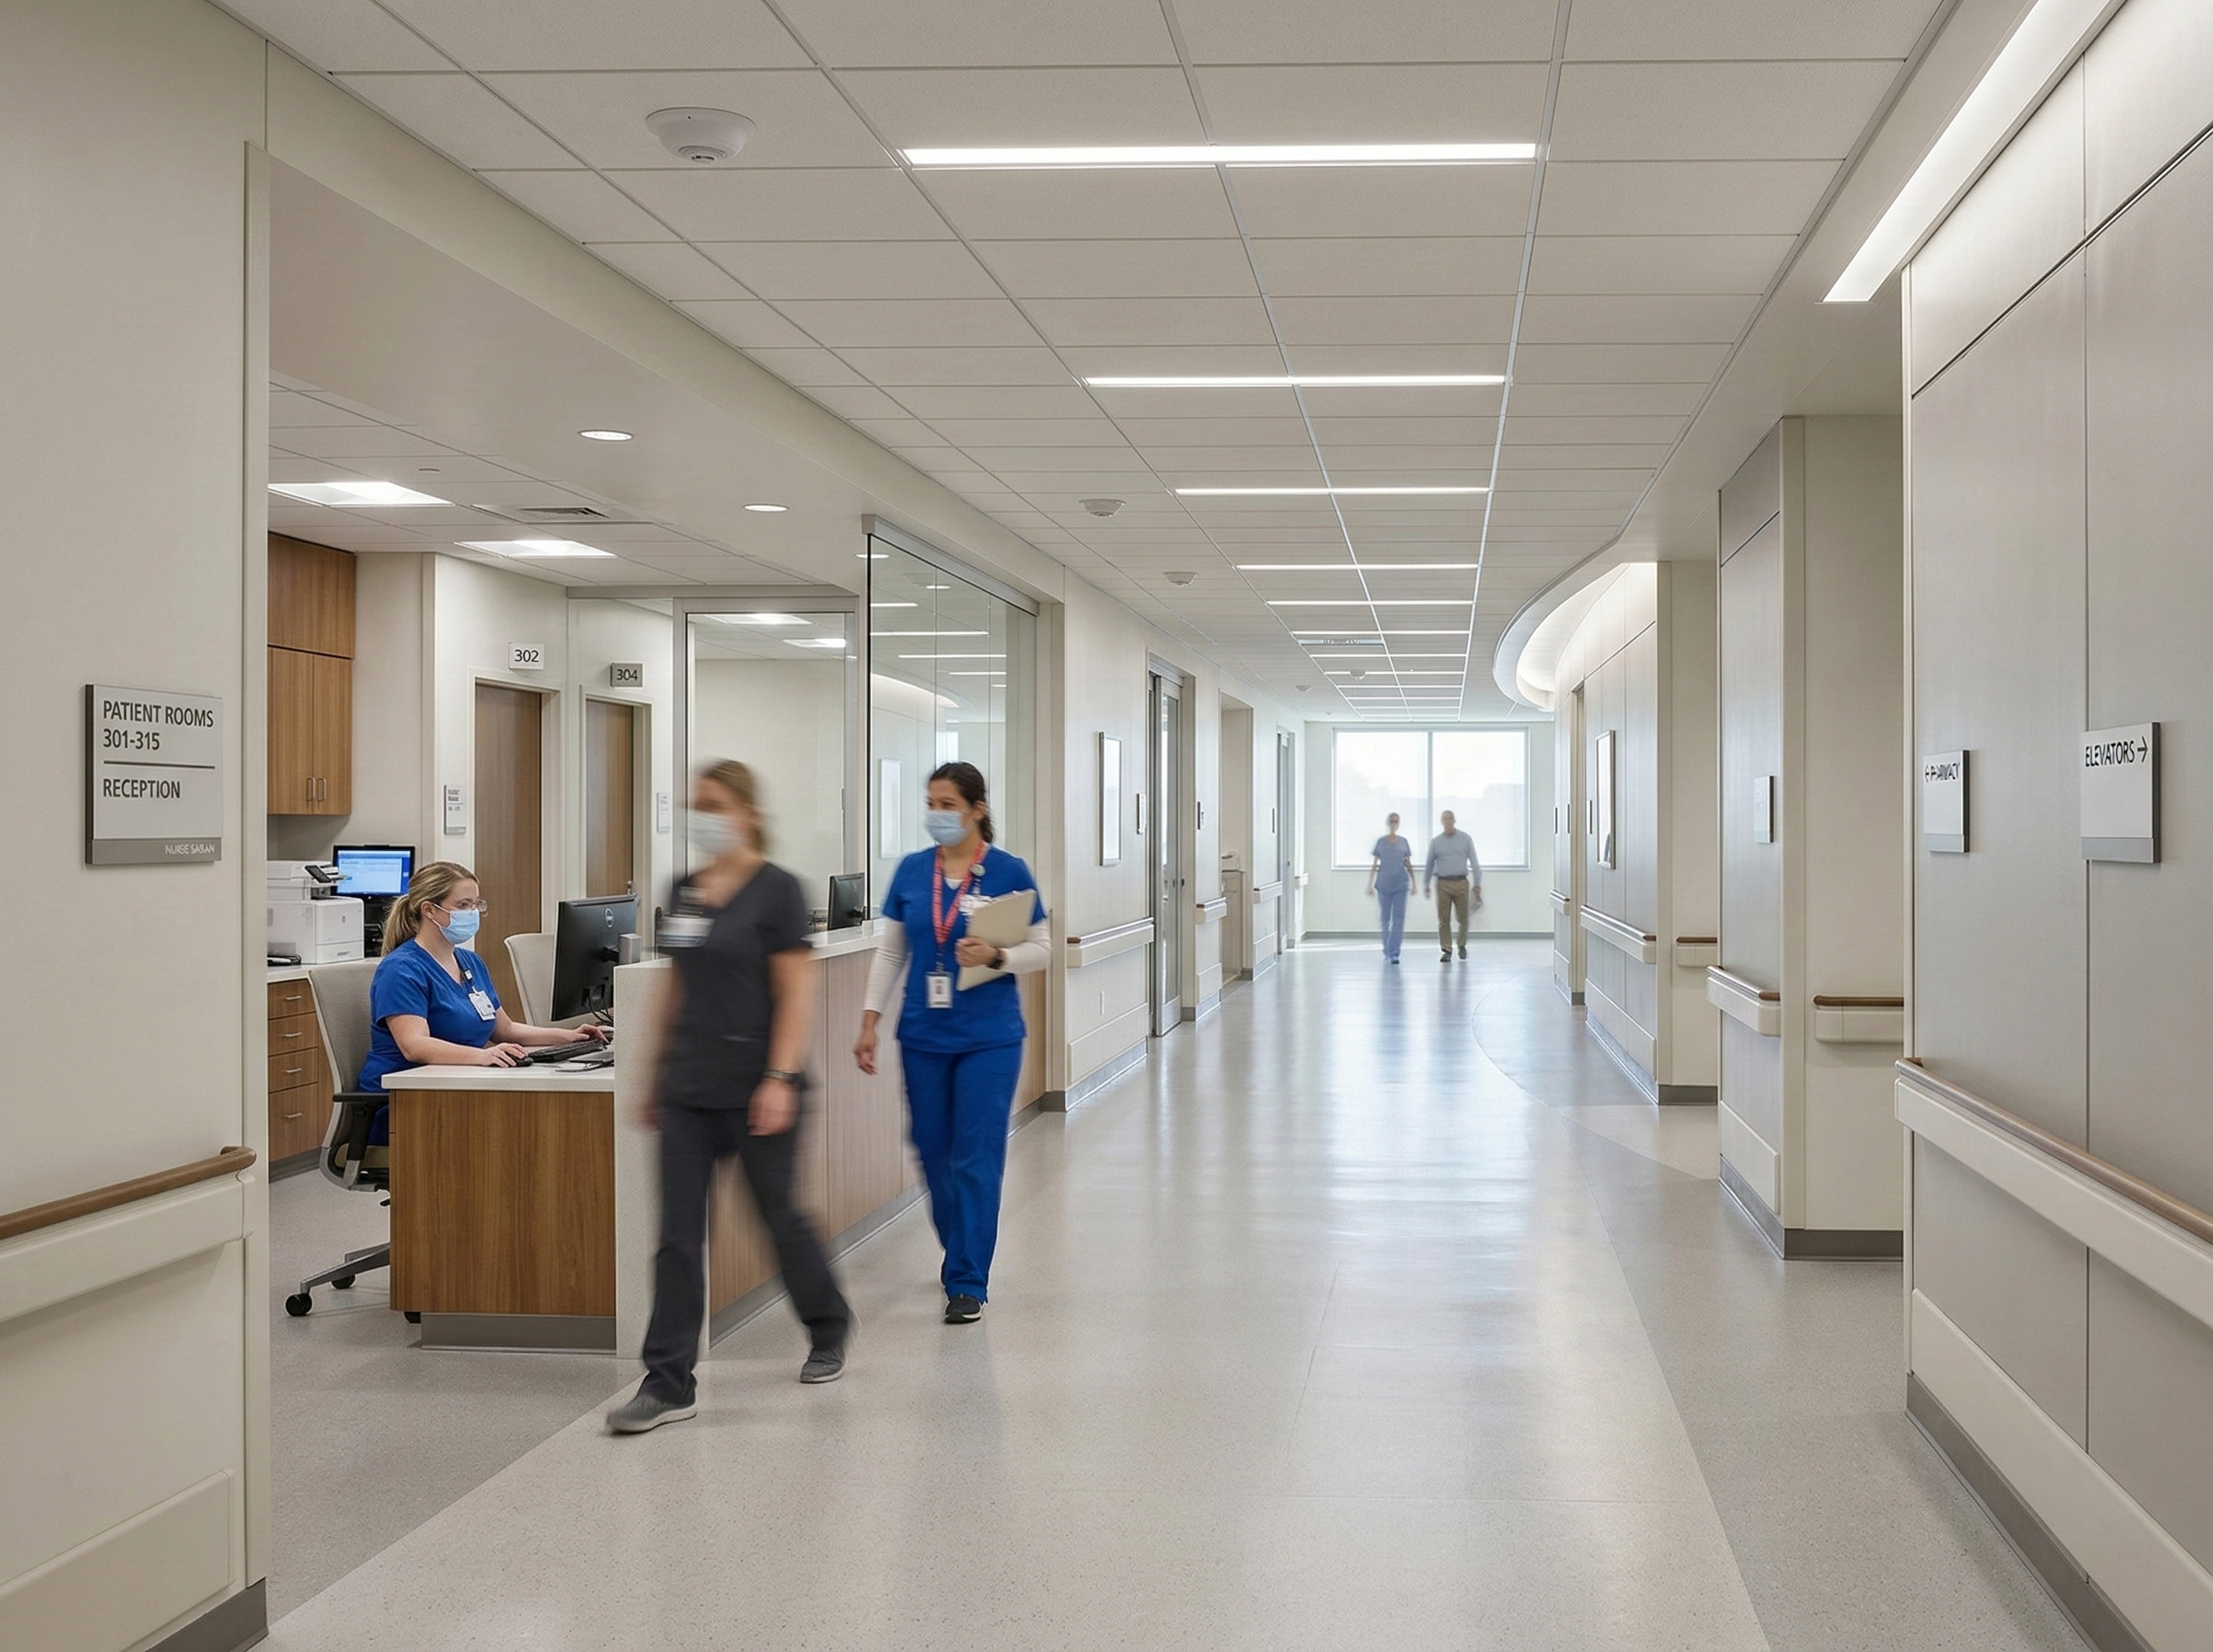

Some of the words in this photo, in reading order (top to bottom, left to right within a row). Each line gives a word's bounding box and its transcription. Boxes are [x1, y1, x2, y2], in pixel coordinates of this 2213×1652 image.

[514, 649, 539, 663] 302
[616, 668, 638, 681] 304
[103, 700, 161, 723] PATIENT
[165, 706, 214, 727] ROOMS
[103, 728, 160, 750] 301-315
[2085, 740, 2135, 767] ELEVATORS
[103, 778, 181, 799] RECEPTION
